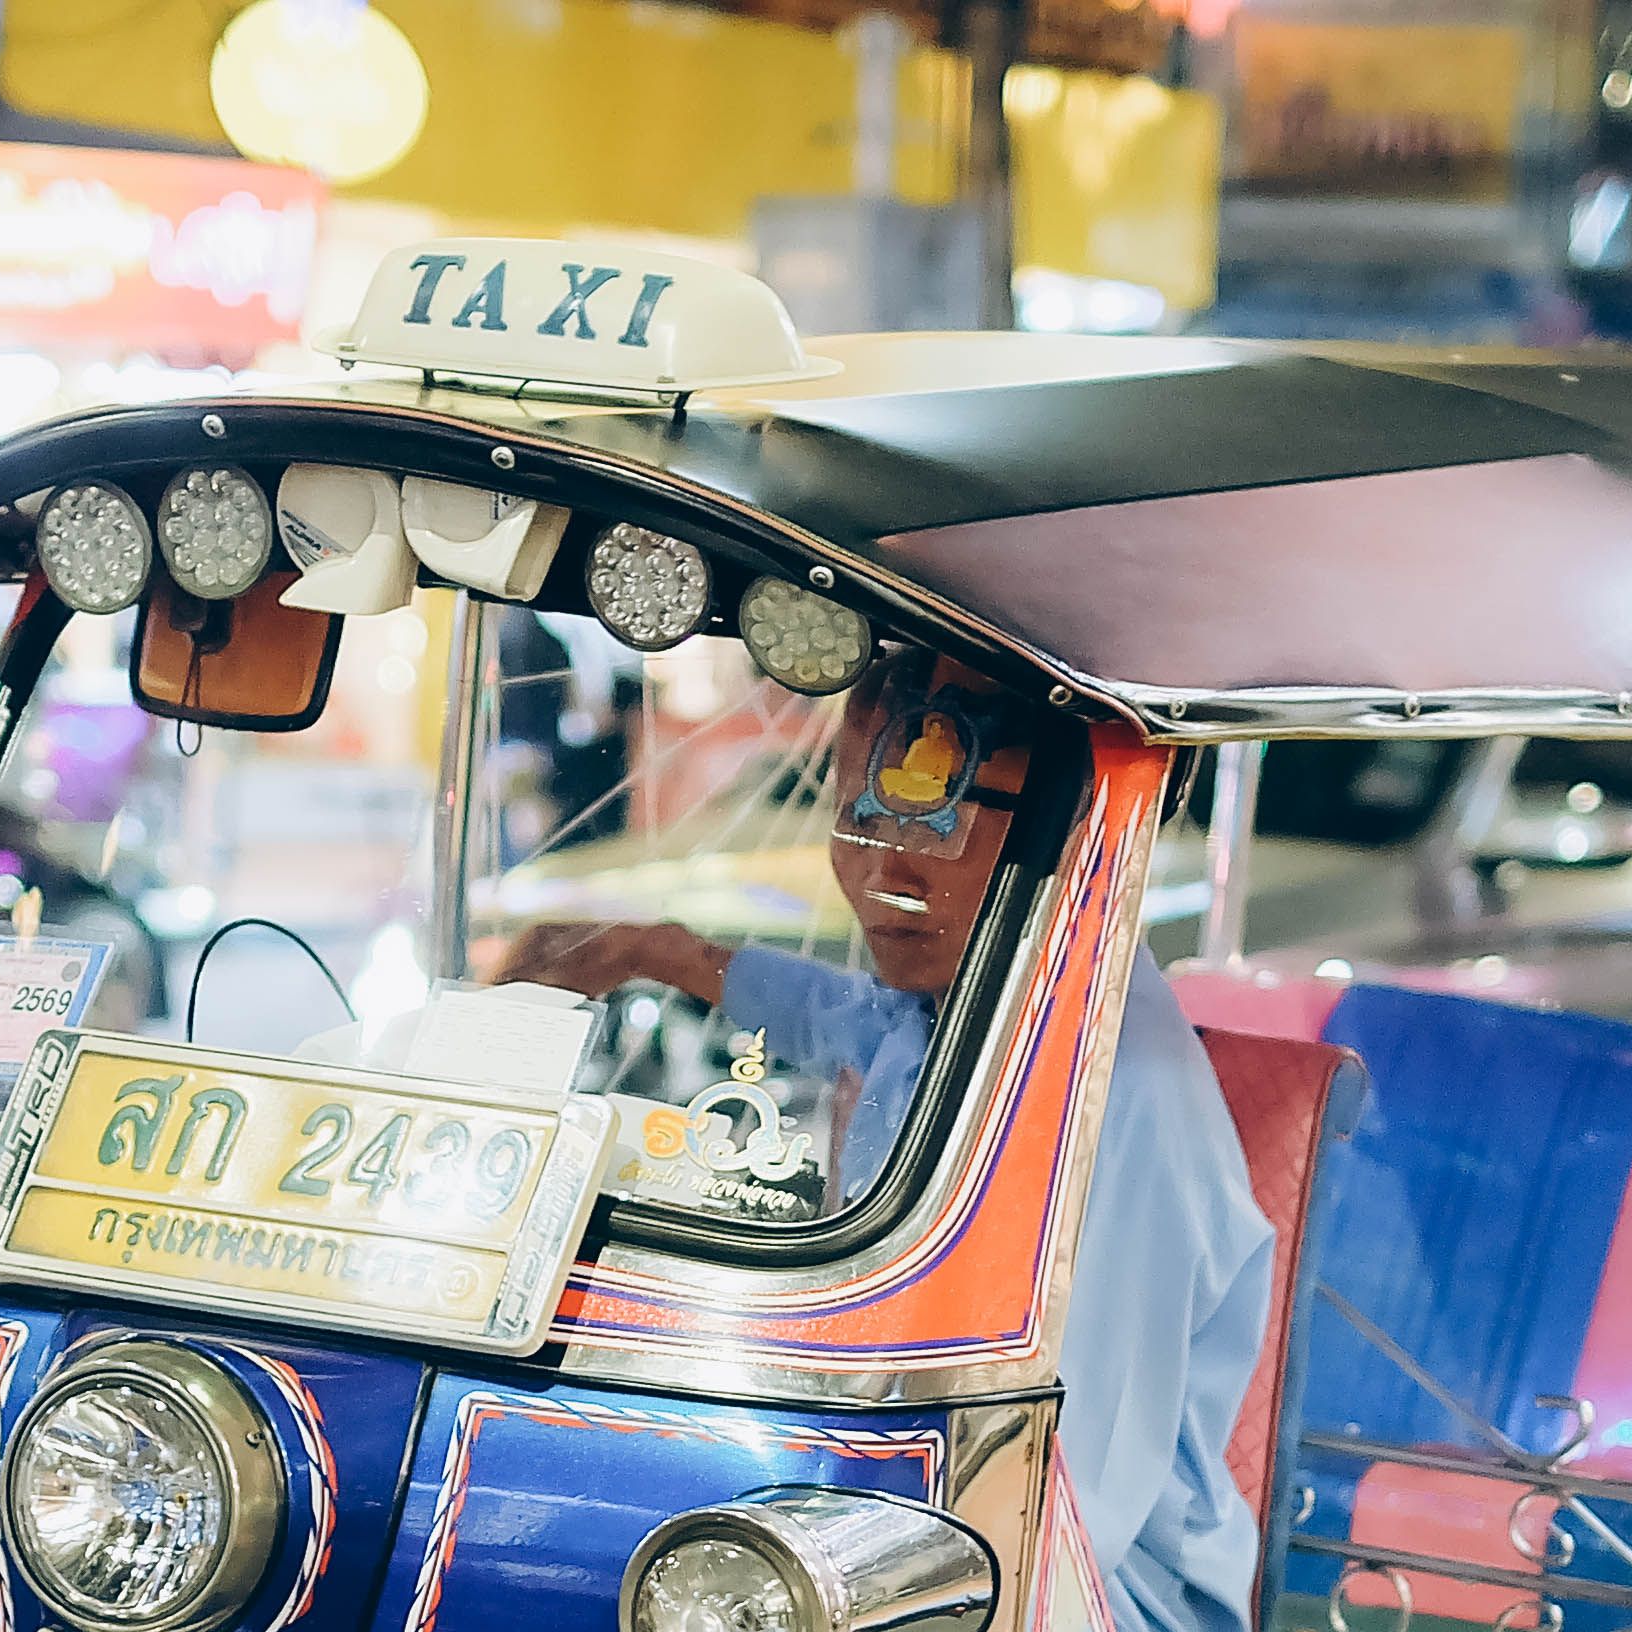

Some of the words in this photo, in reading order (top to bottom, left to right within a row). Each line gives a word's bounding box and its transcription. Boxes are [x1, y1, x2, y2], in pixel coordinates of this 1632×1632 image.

[403, 254, 673, 347] TAXI
[11, 986, 73, 1016] 2569
[4, 1038, 68, 1151] TRD
[98, 1075, 248, 1181] สก
[278, 1103, 530, 1220] 2439
